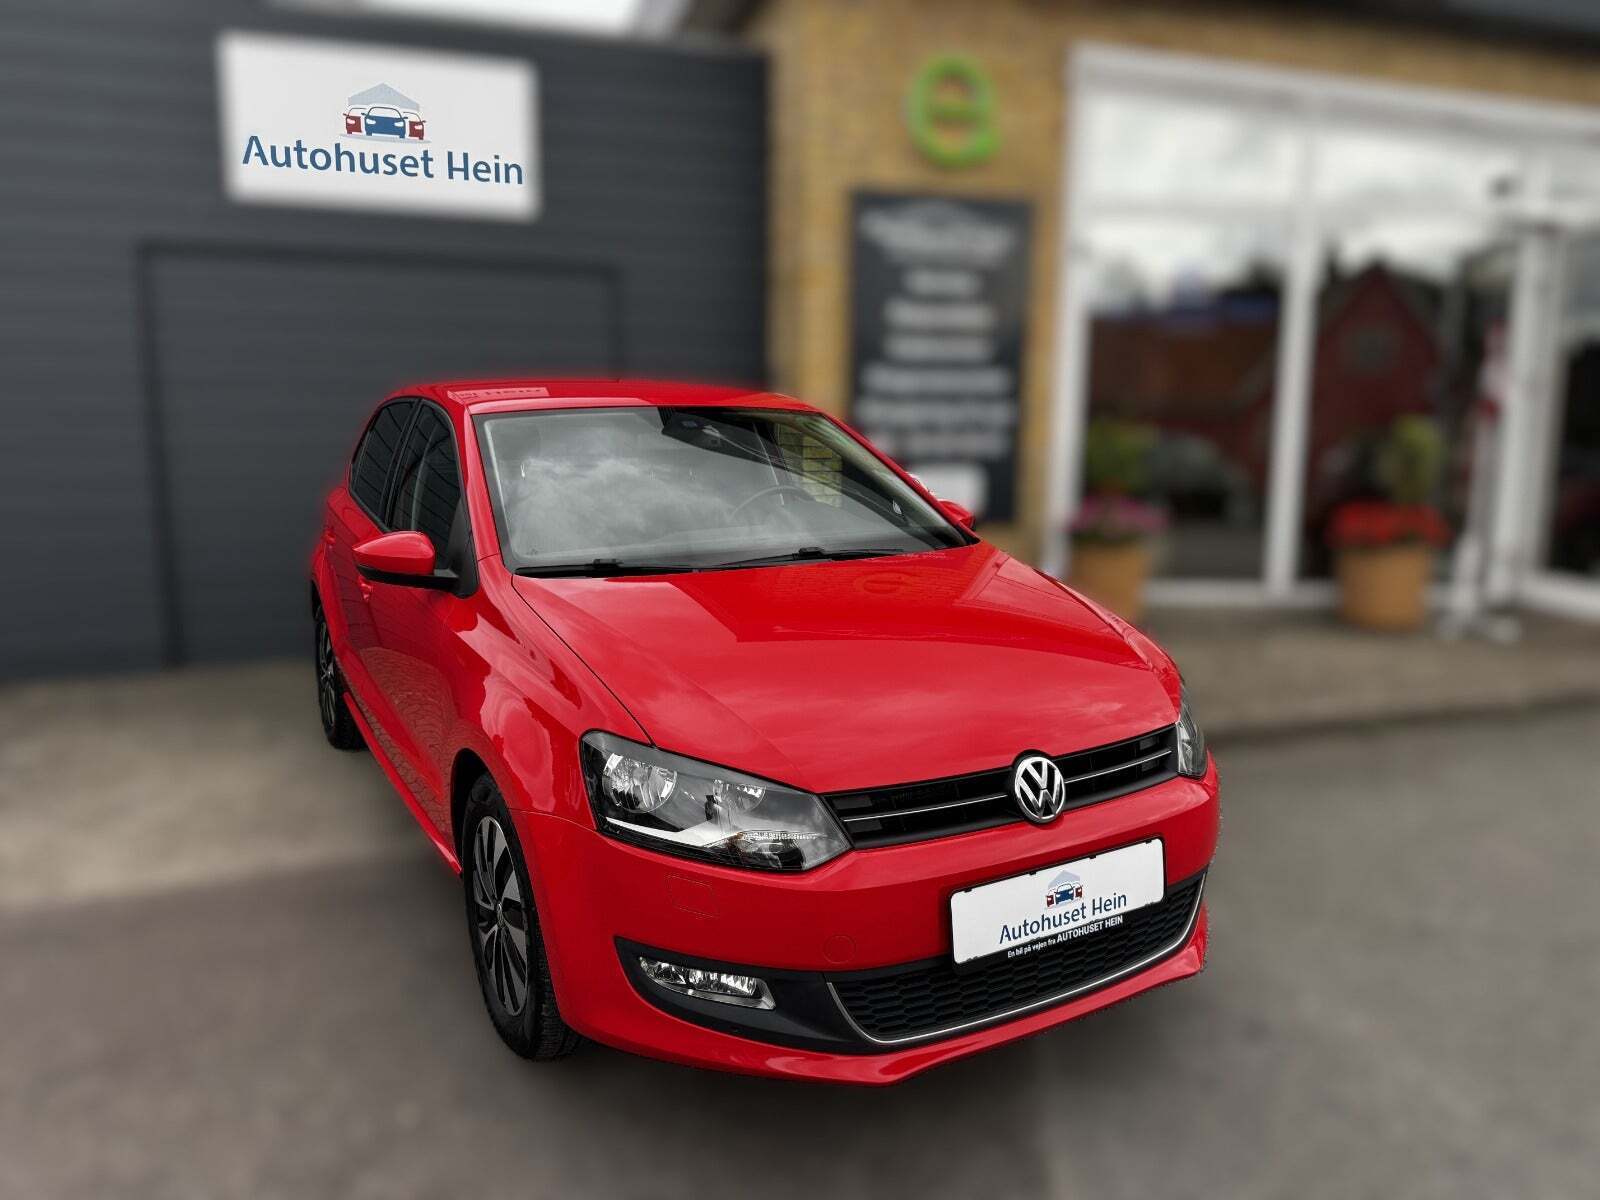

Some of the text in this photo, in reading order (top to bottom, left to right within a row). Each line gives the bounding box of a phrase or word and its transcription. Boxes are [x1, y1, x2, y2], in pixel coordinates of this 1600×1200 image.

[242, 135, 523, 184] Autohuset Hein
[999, 892, 1127, 944] Autohuset Hein
[1007, 950, 1016, 959] En
[1048, 938, 1056, 946] fra
[1057, 922, 1104, 943] AUTOHUSET
[1105, 915, 1123, 928] HEIN
